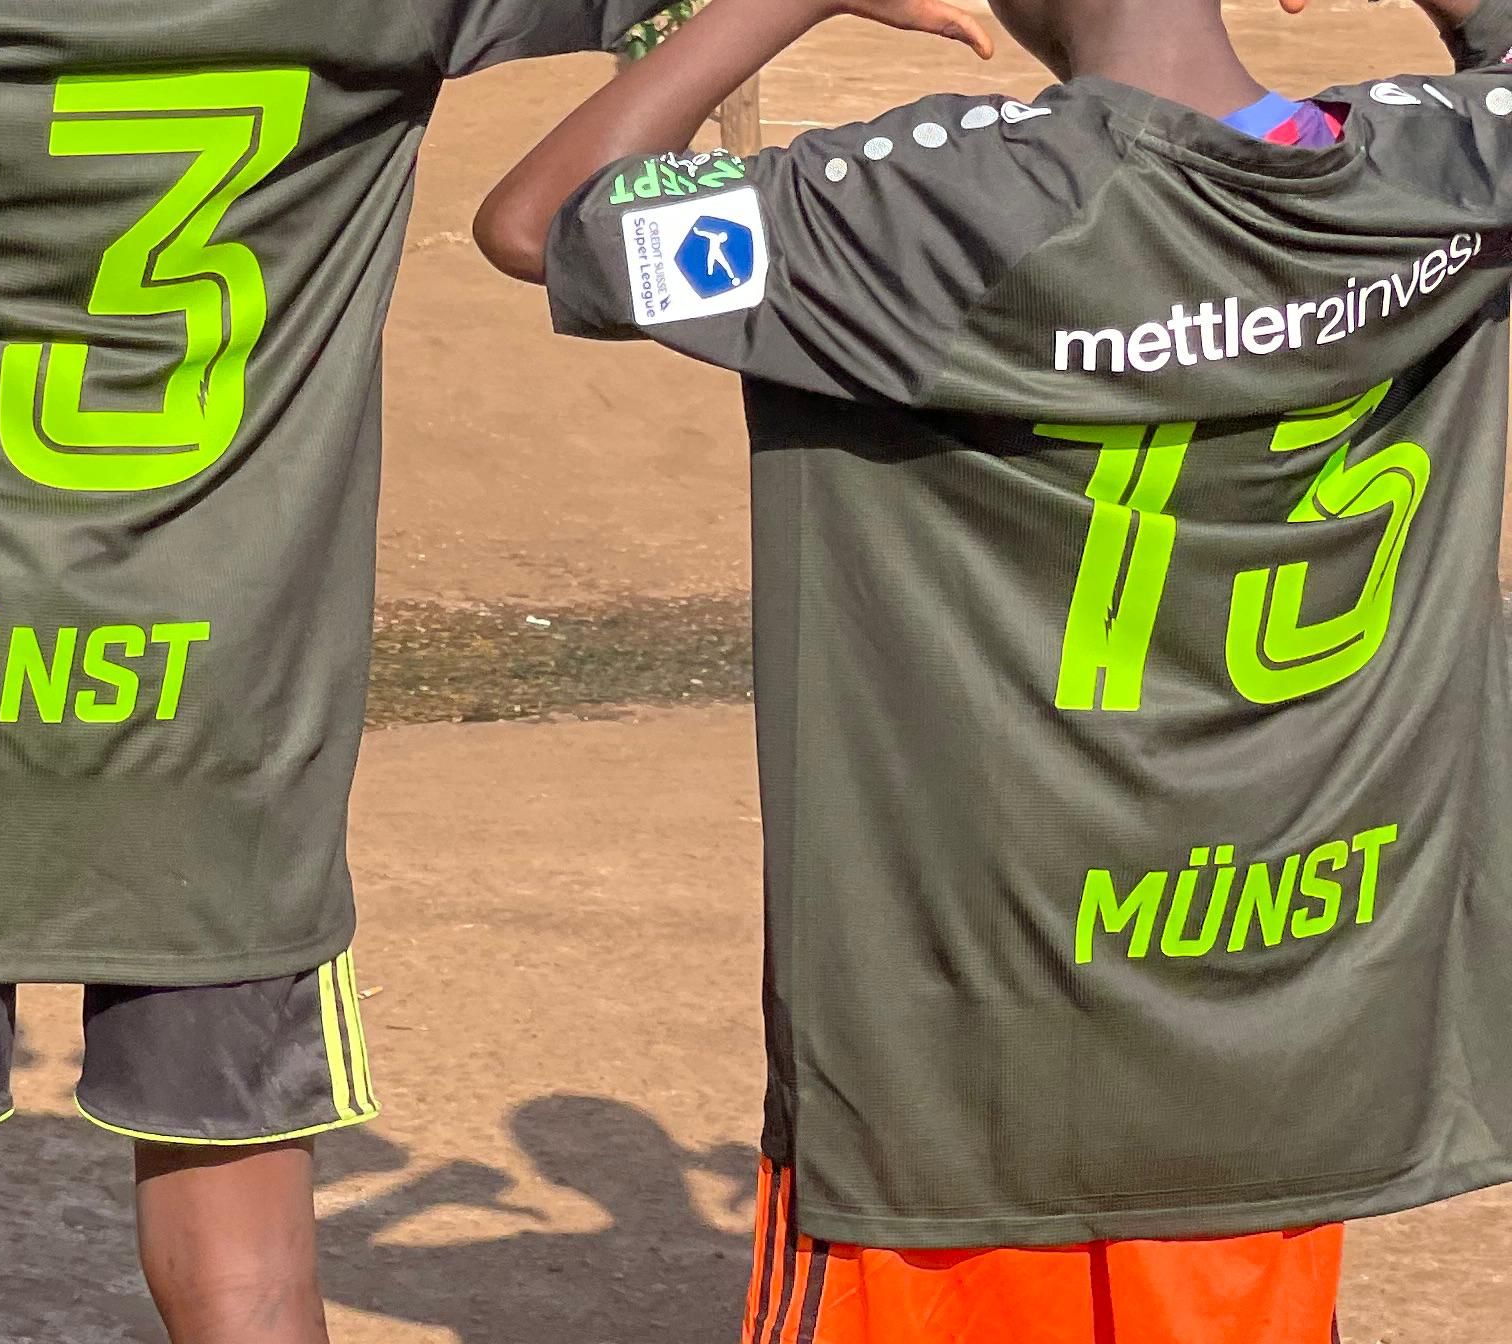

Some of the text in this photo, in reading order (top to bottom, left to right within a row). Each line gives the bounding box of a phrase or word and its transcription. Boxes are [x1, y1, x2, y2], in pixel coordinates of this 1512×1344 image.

[634, 217, 656, 318] Super League
[649, 221, 668, 295] CREDIT SUISSE
[1074, 823, 1399, 967] MÜNST
